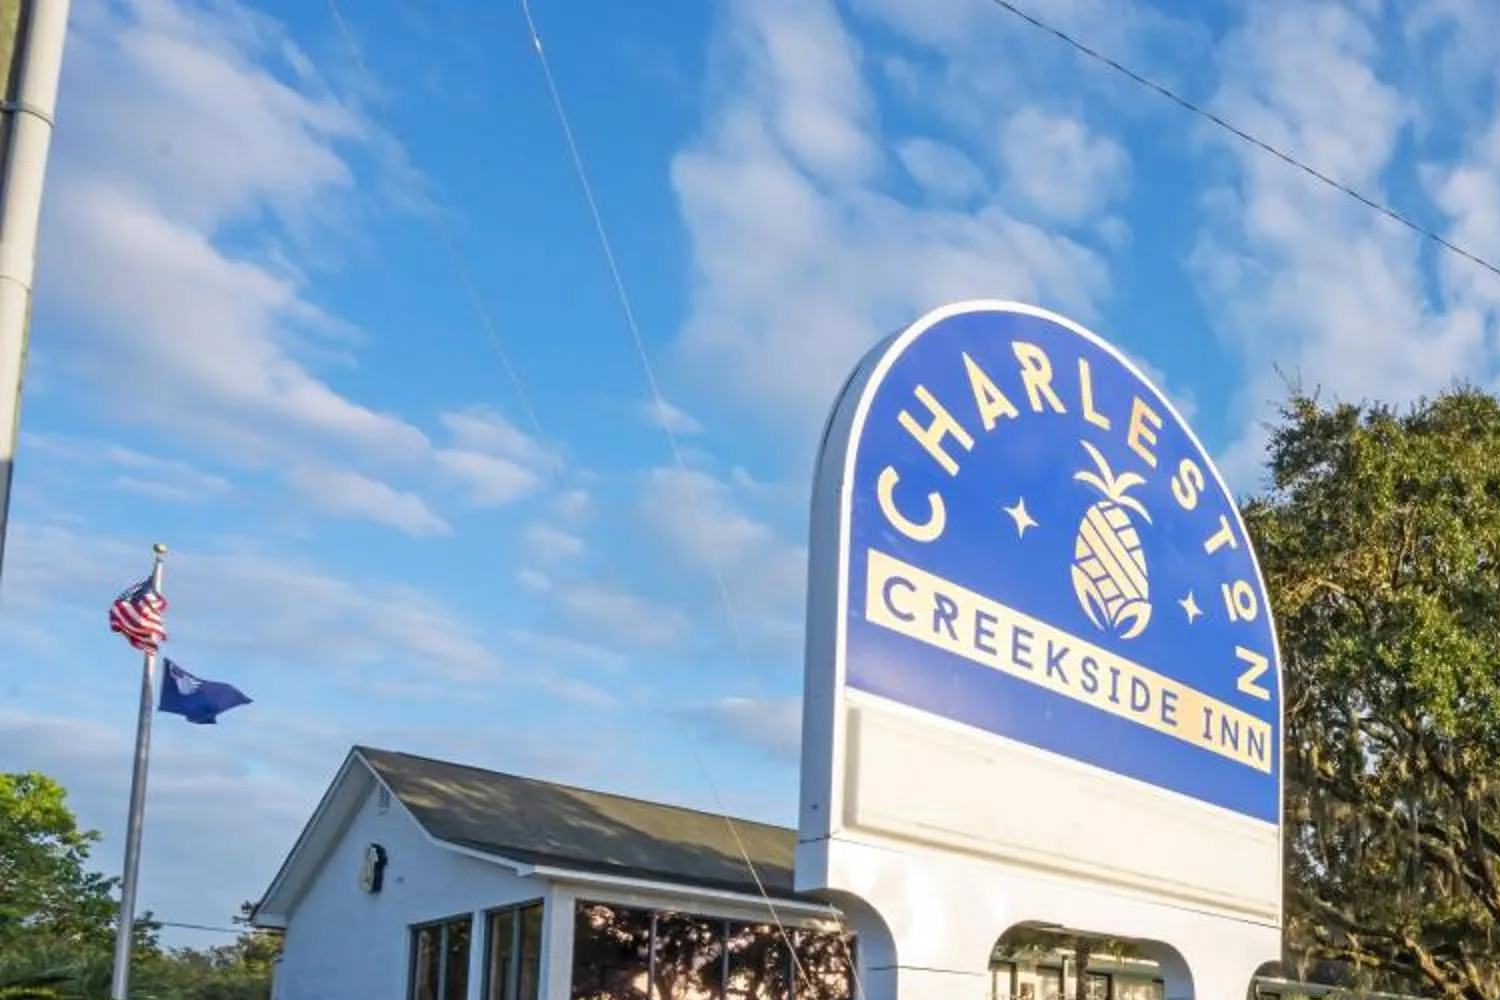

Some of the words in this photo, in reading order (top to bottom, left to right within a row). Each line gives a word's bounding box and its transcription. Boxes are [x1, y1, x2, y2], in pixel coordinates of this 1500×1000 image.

[878, 341, 1271, 700] CHARLESTON
[882, 575, 1180, 726] CREEKSIDE
[1202, 706, 1267, 763] INN
